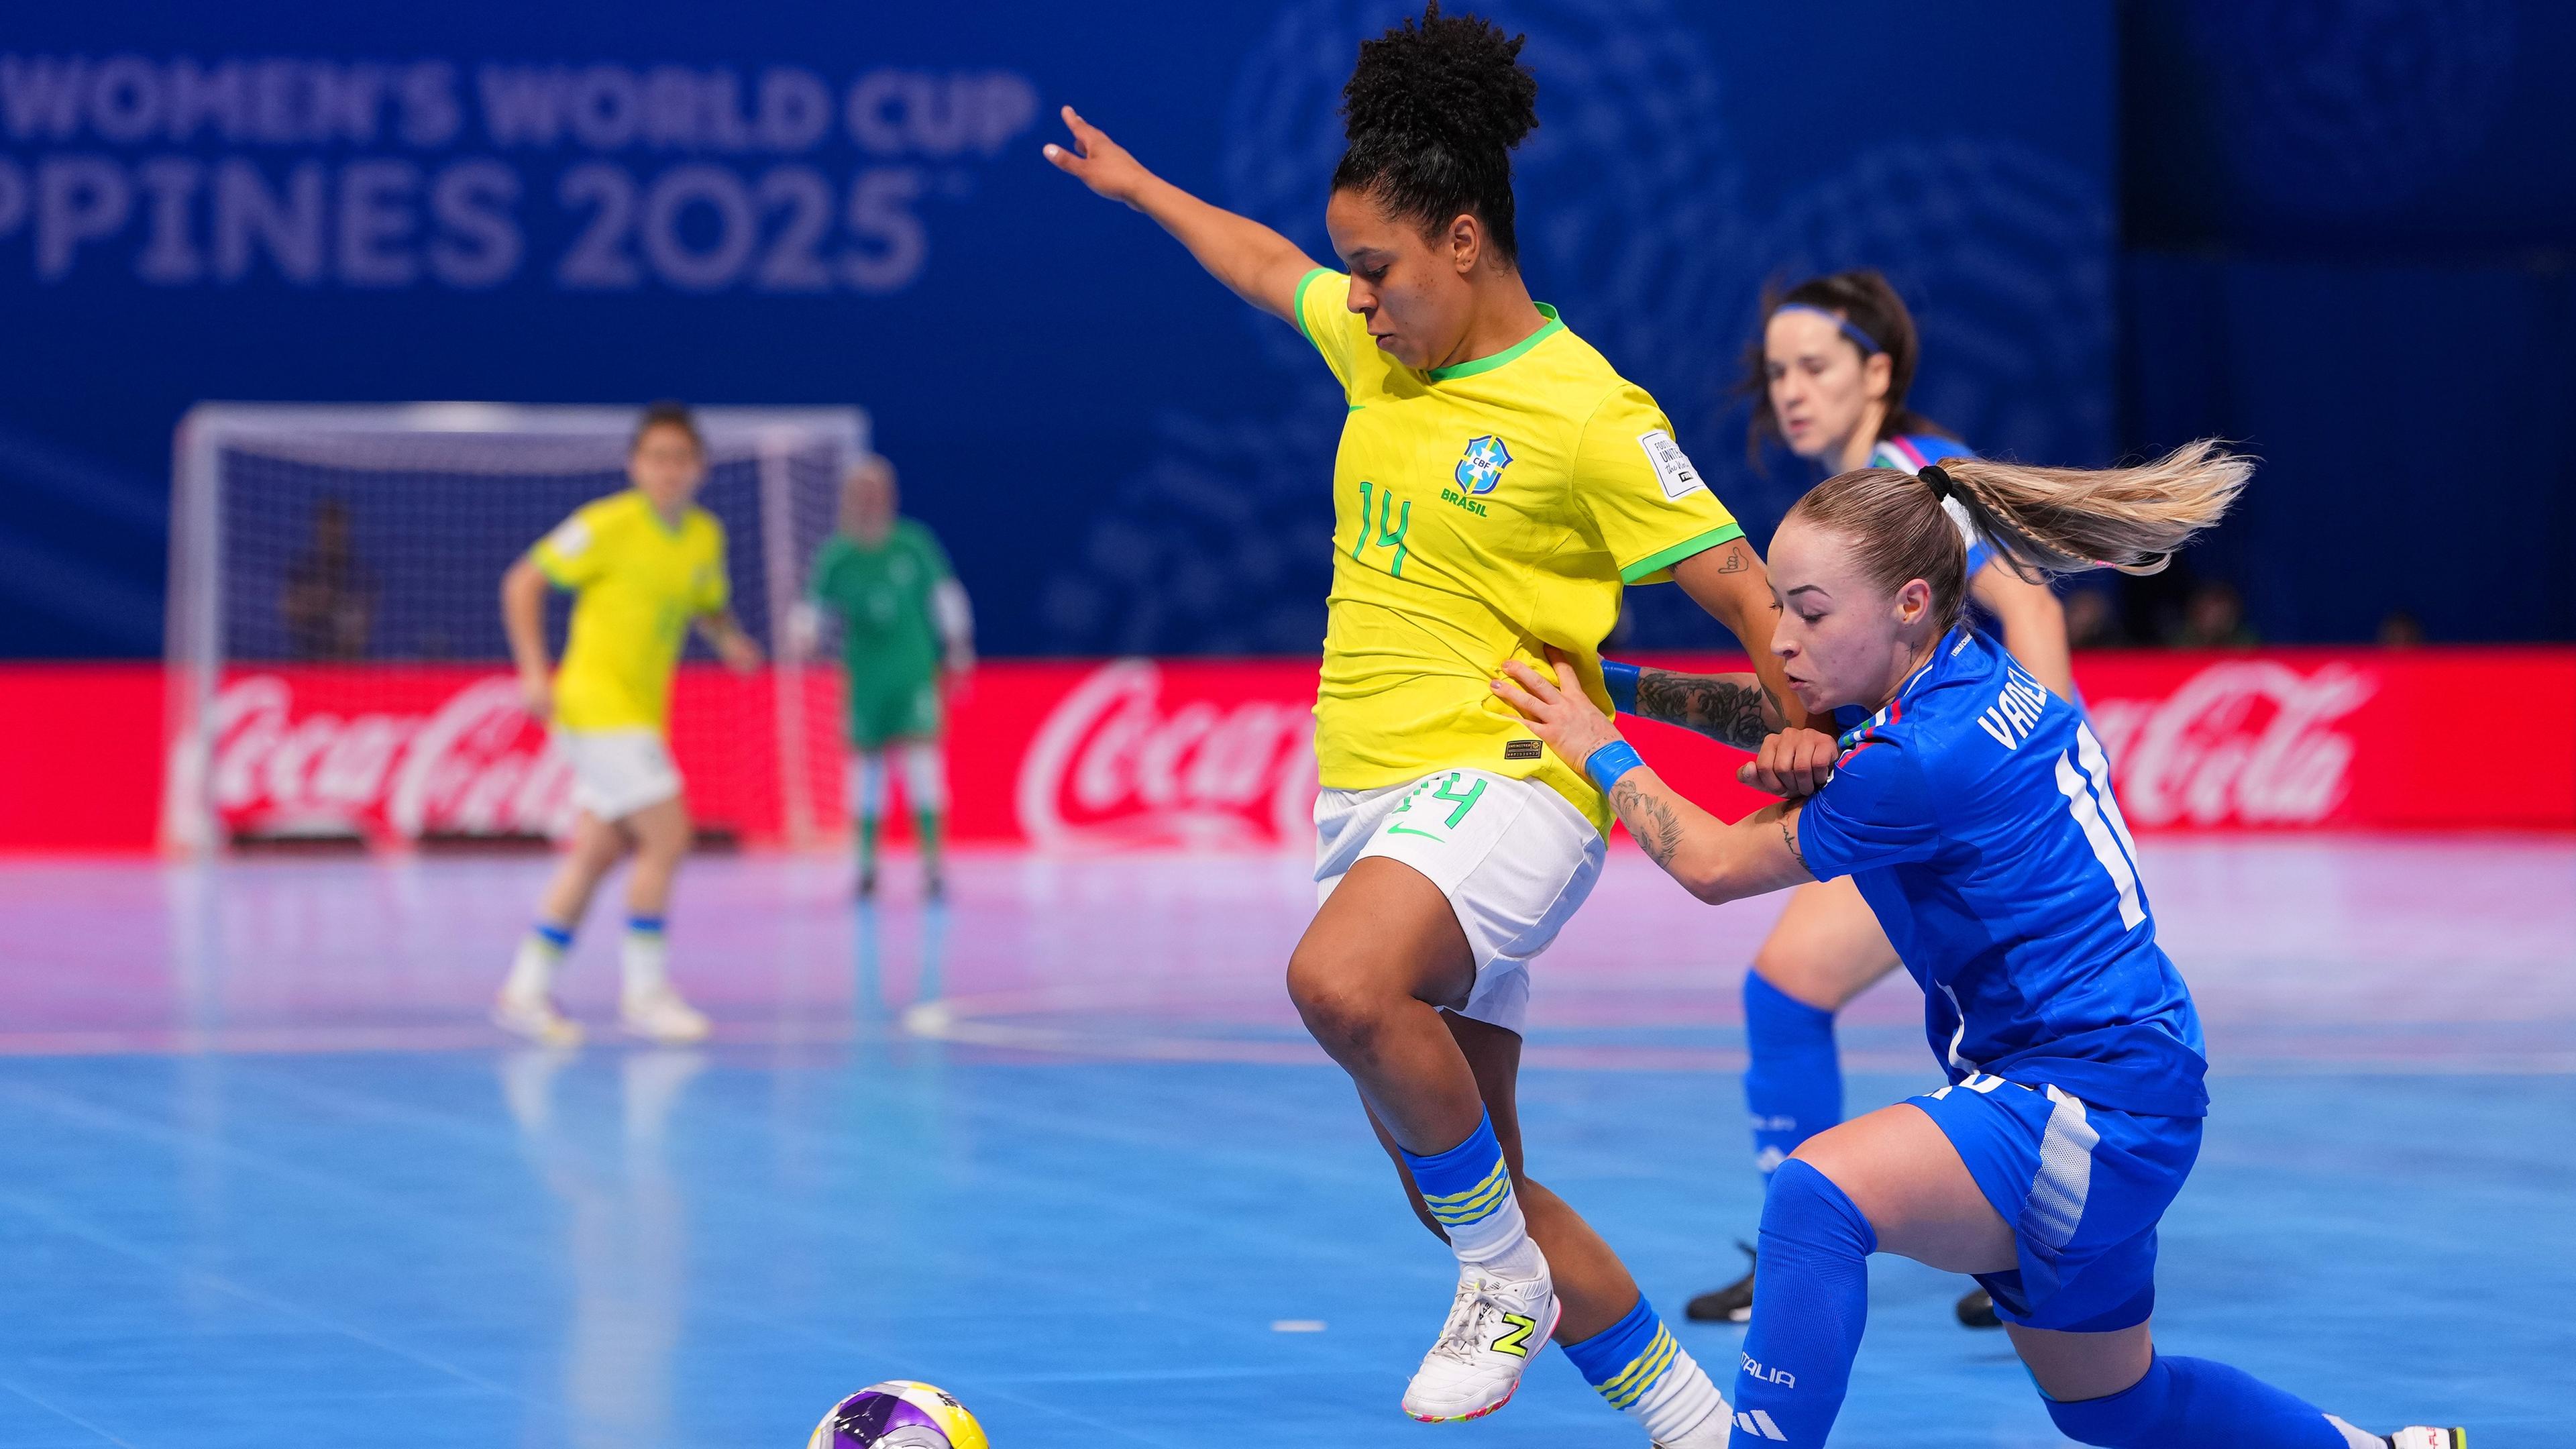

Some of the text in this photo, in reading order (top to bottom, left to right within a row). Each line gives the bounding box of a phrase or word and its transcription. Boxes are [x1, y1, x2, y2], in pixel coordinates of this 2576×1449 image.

[3, 56, 1037, 156] WOMEN'S WORLD CUP
[554, 164, 930, 292] 2025
[1472, 457, 1491, 469] CBF
[1352, 482, 1411, 579] 14
[1440, 488, 1488, 518] BRASIL
[1490, 1311, 1536, 1359] N
